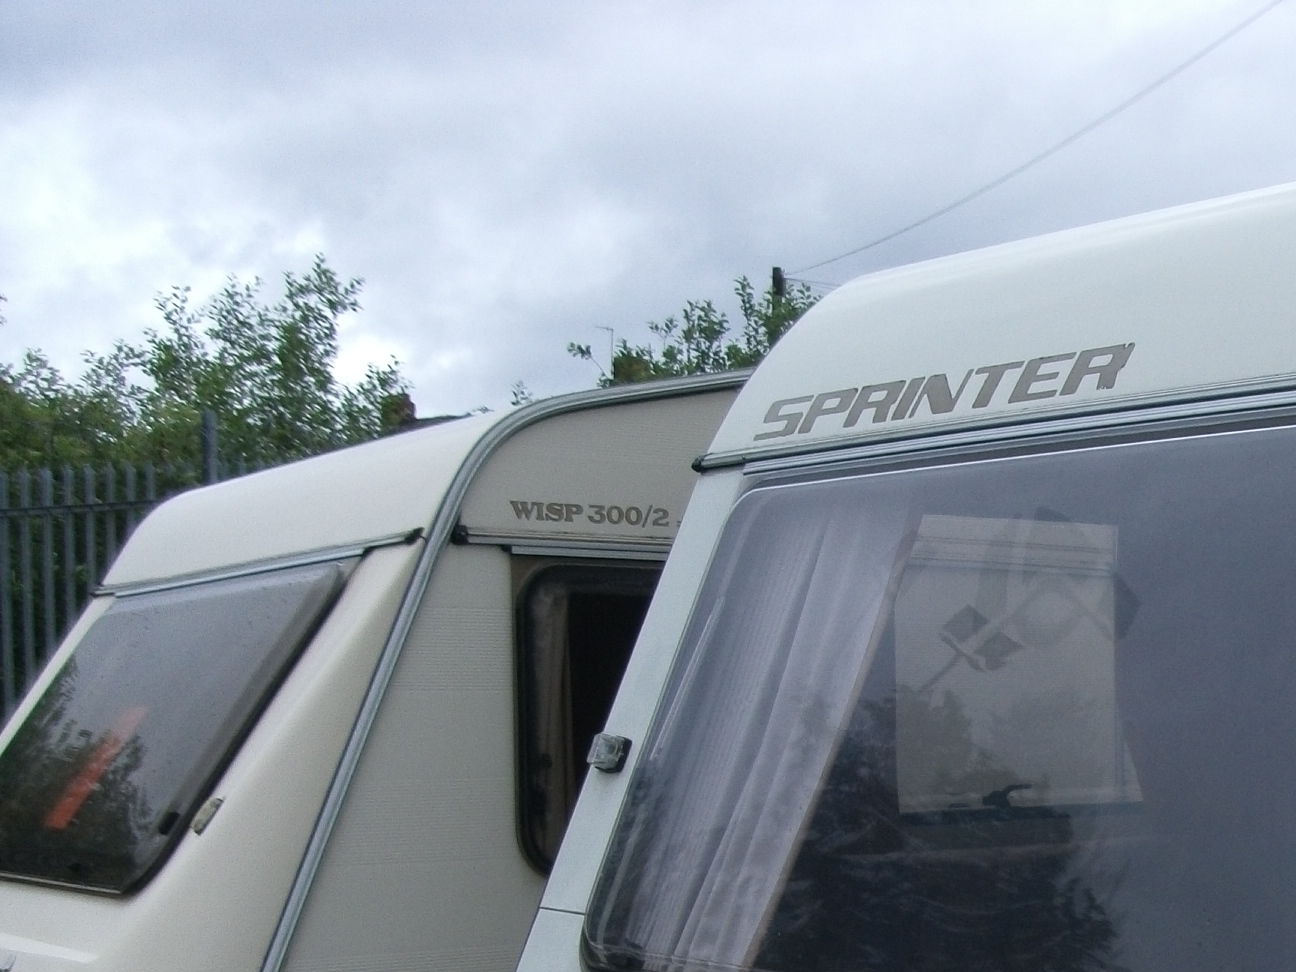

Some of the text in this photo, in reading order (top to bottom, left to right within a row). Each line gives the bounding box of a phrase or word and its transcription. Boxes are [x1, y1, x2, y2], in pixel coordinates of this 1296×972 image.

[753, 342, 1136, 442] SPRINTER
[509, 501, 670, 528] WISP 300/2
